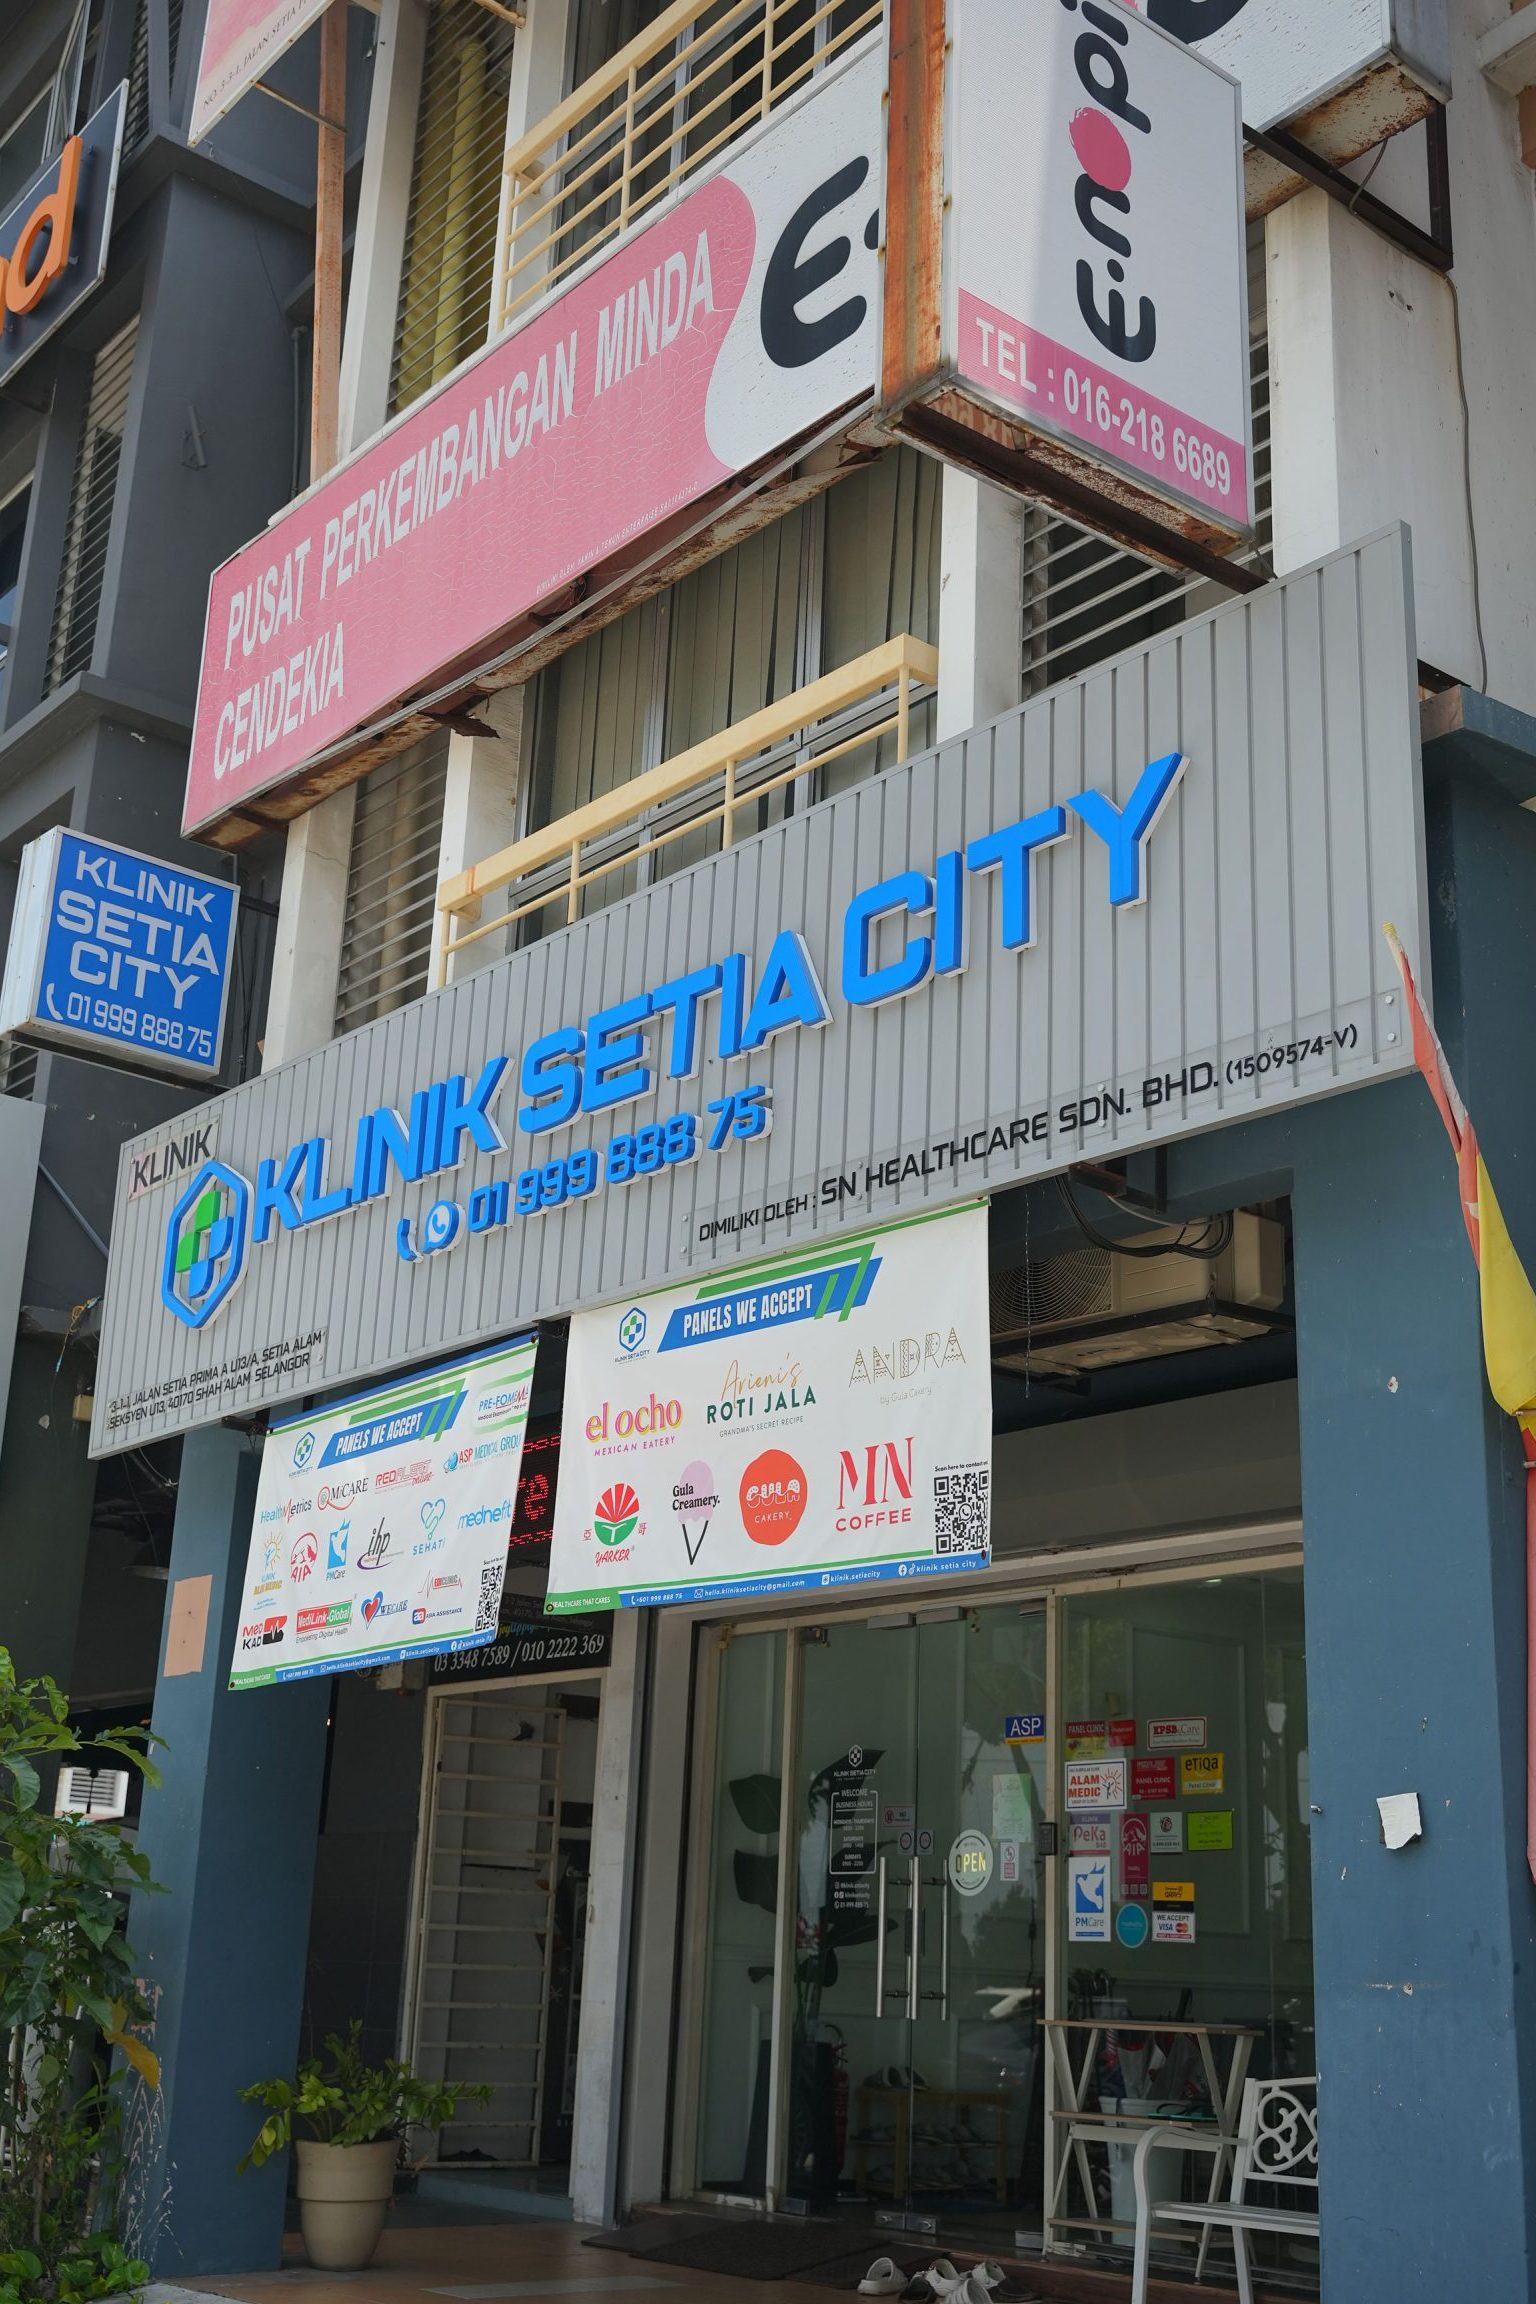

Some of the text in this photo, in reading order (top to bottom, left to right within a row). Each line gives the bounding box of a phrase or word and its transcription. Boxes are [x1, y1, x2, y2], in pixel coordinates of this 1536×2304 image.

[976, 317, 1037, 394] TEL
[1063, 367, 1166, 462] 016-218
[1172, 427, 1232, 495] 6689
[224, 229, 714, 672] PUSAT PERKEMBANGAN MINDA
[213, 622, 345, 780] CENDEKIA
[75, 849, 216, 924] KLINIK
[56, 889, 220, 976] SETIA
[69, 940, 201, 1010] CITY
[252, 752, 1191, 1246] KLINIK SETIA CITY
[66, 991, 213, 1059] 01 999 888 75
[699, 1211, 760, 1242] DIMILIKI
[820, 1170, 857, 1206] SN
[865, 1111, 1049, 1192] HEALTHCARE
[1059, 1088, 1132, 1134] SDN.
[1142, 1061, 1220, 1109] BHD.
[1225, 1022, 1358, 1085] (1509574-V)
[131, 1123, 214, 1194] KLINIK
[468, 1084, 773, 1236] 01 999 888 75
[683, 1283, 814, 1339] PANELS WE ACCEPT
[132, 1386, 161, 1406] JALAN
[162, 1377, 188, 1396] SETIA
[189, 1367, 220, 1388] PRIMA
[221, 1365, 228, 1379] A
[261, 1342, 291, 1363] SETIA
[292, 1329, 323, 1353] ALAM
[848, 1327, 967, 1388] ANDRA
[109, 1409, 148, 1430] SEKSYEN
[167, 1393, 194, 1413] 40170
[195, 1383, 222, 1403] SHAH
[223, 1374, 251, 1395] ALAM
[254, 1352, 310, 1383] SELANGOR
[706, 1384, 817, 1425] ROTI JALA
[585, 1393, 683, 1443] el ocho
[719, 1415, 804, 1438] GRANDMA'S SECRET RECIPE
[335, 1412, 423, 1458] PANELS WE ACCEPT
[594, 1435, 676, 1457] MEXICAN EATERY
[458, 1448, 474, 1464] ASP
[672, 1483, 694, 1498] Gula
[672, 1493, 720, 1512] Creamery.
[835, 1507, 912, 1532] COFFEE
[595, 1548, 630, 1567] YARKER
[915, 1559, 977, 1573] klinik setia city
[290, 1564, 312, 1583] AIA
[434, 1655, 448, 1673] 03
[450, 1650, 479, 1670] 3348
[481, 1644, 510, 1668] 7589
[521, 1640, 545, 1662] 010
[546, 1636, 579, 1659] 2222
[579, 1633, 605, 1655] 369
[1011, 1717, 1042, 1737] ASP
[1068, 1725, 1086, 1734] PANEL
[841, 1788, 869, 1797] WELCOME
[1068, 1786, 1101, 1798] MEDIC
[1070, 1775, 1100, 1786] ALAM
[1136, 1777, 1153, 1785] PANEL
[1122, 1842, 1146, 1856] AIA
[956, 1852, 987, 1874] OPEN
[1075, 1917, 1105, 1928] PMCare
[1157, 1914, 1167, 1922] WE
[1159, 1923, 1174, 1931] VISA
